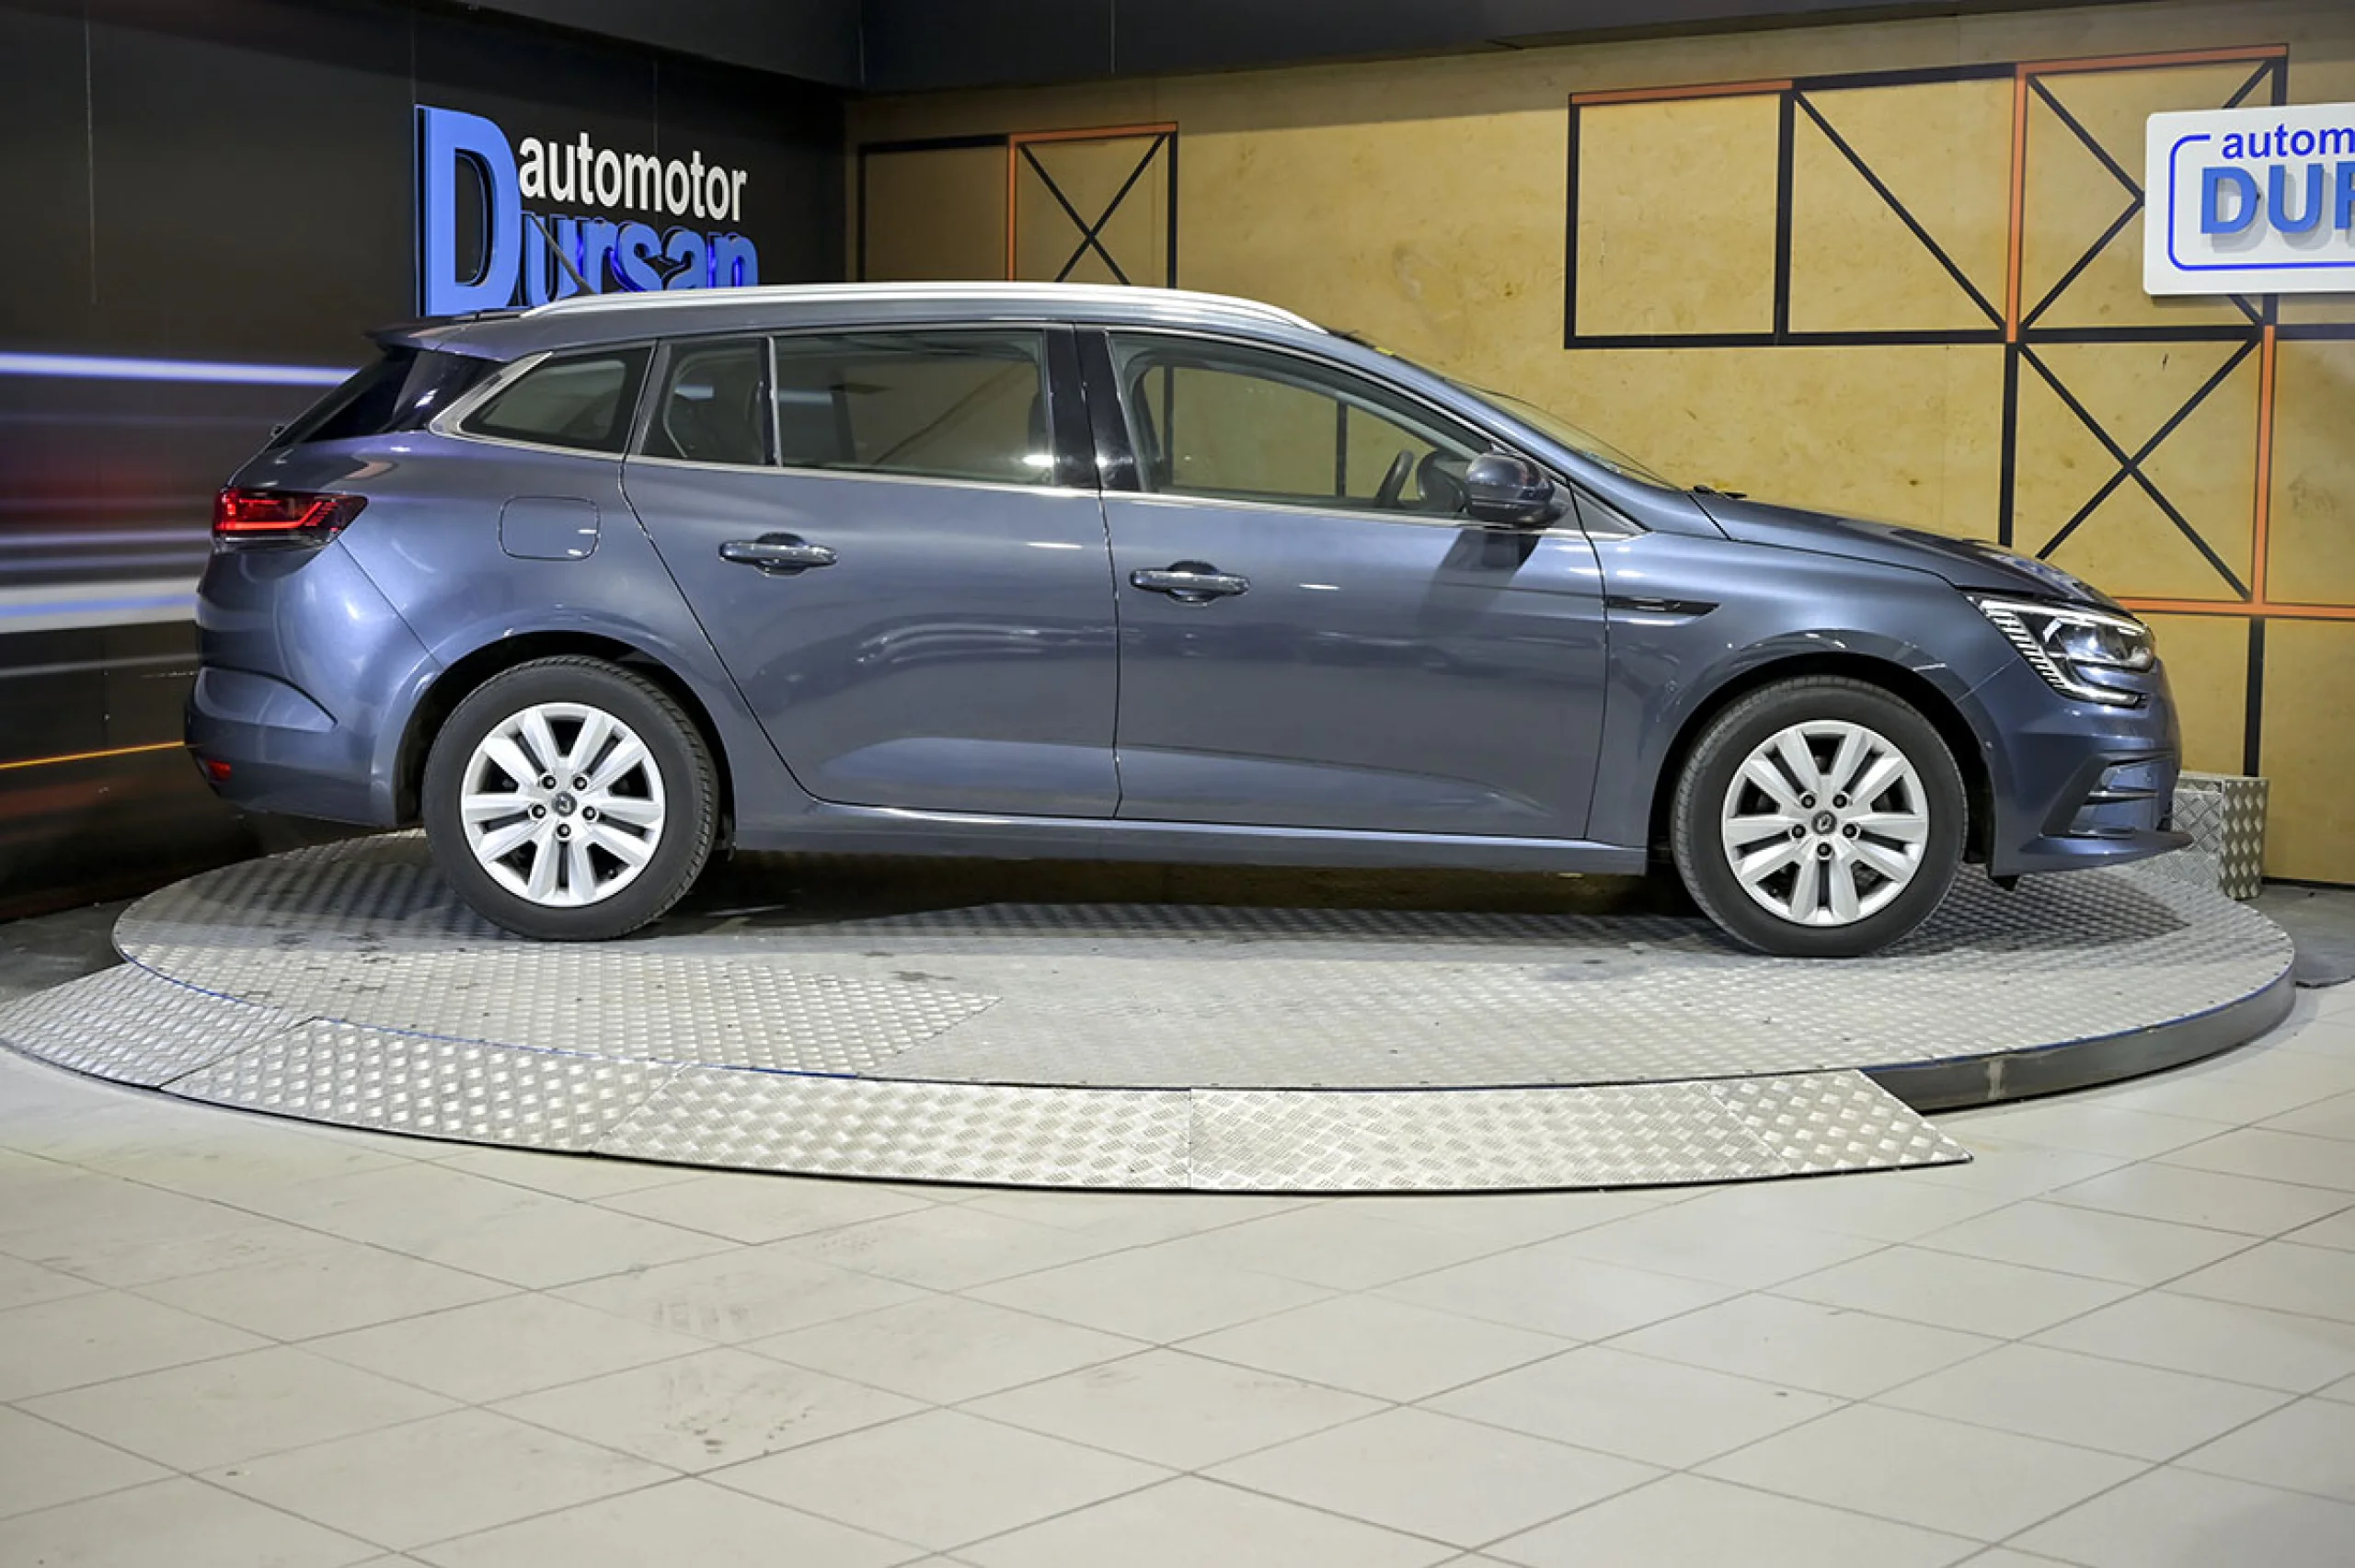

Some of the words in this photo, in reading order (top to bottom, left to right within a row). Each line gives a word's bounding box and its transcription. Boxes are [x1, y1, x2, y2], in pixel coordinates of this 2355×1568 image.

[519, 132, 748, 222] automotor
[2222, 123, 2355, 159] autom
[415, 104, 759, 317] Dursan
